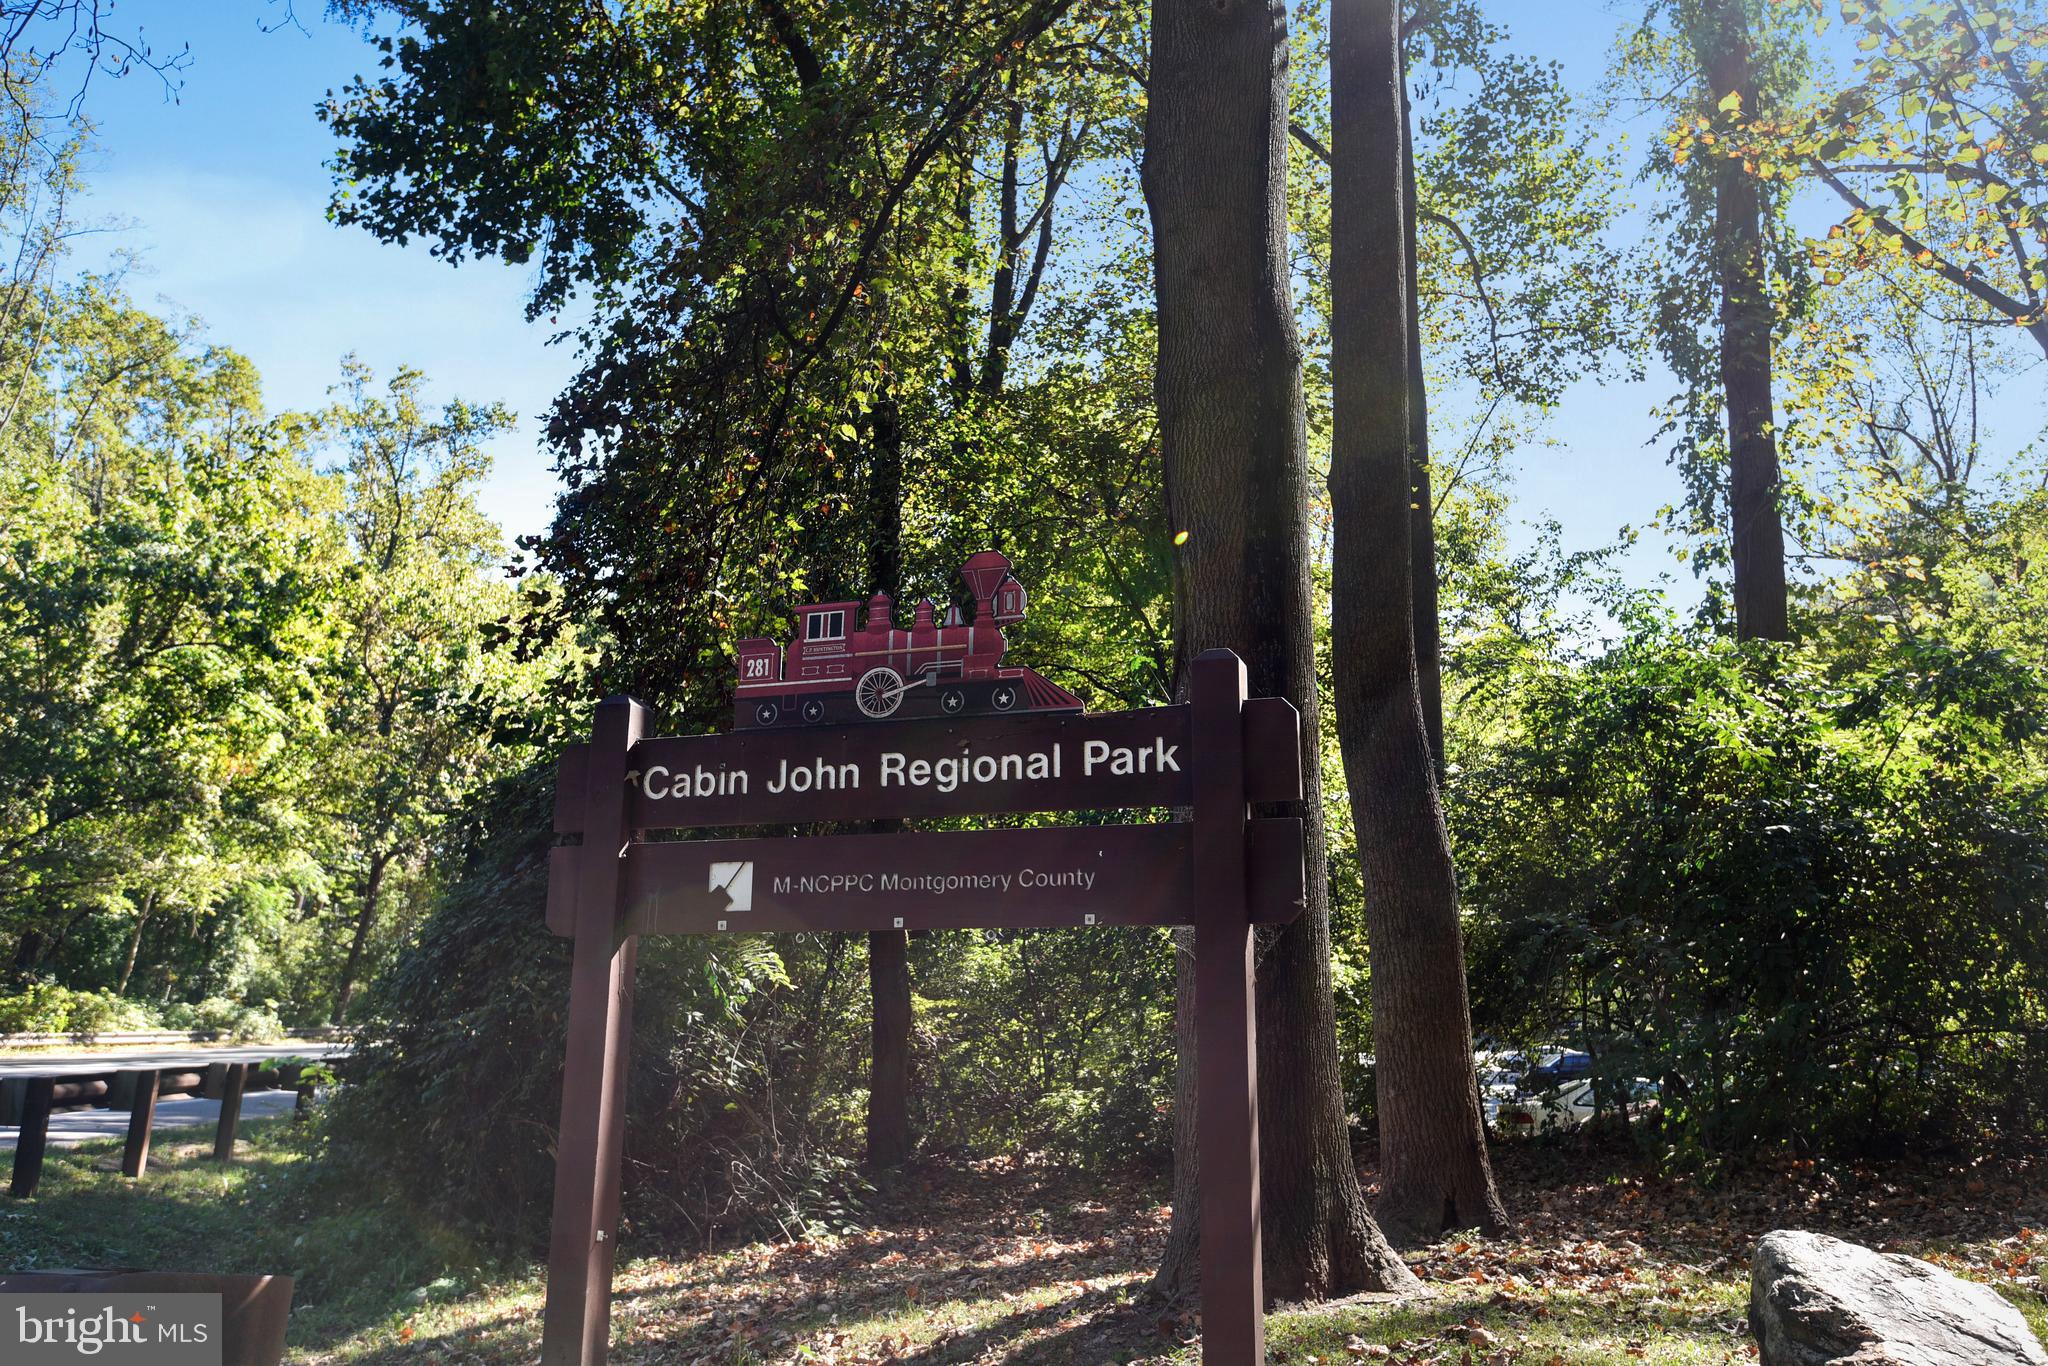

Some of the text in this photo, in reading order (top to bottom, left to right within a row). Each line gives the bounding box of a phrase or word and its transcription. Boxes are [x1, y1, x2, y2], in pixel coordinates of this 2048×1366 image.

[746, 658, 769, 677] 281
[643, 736, 1181, 800] Cabin John Regional Park
[773, 868, 1096, 894] M-NCPPC Montgomery County
